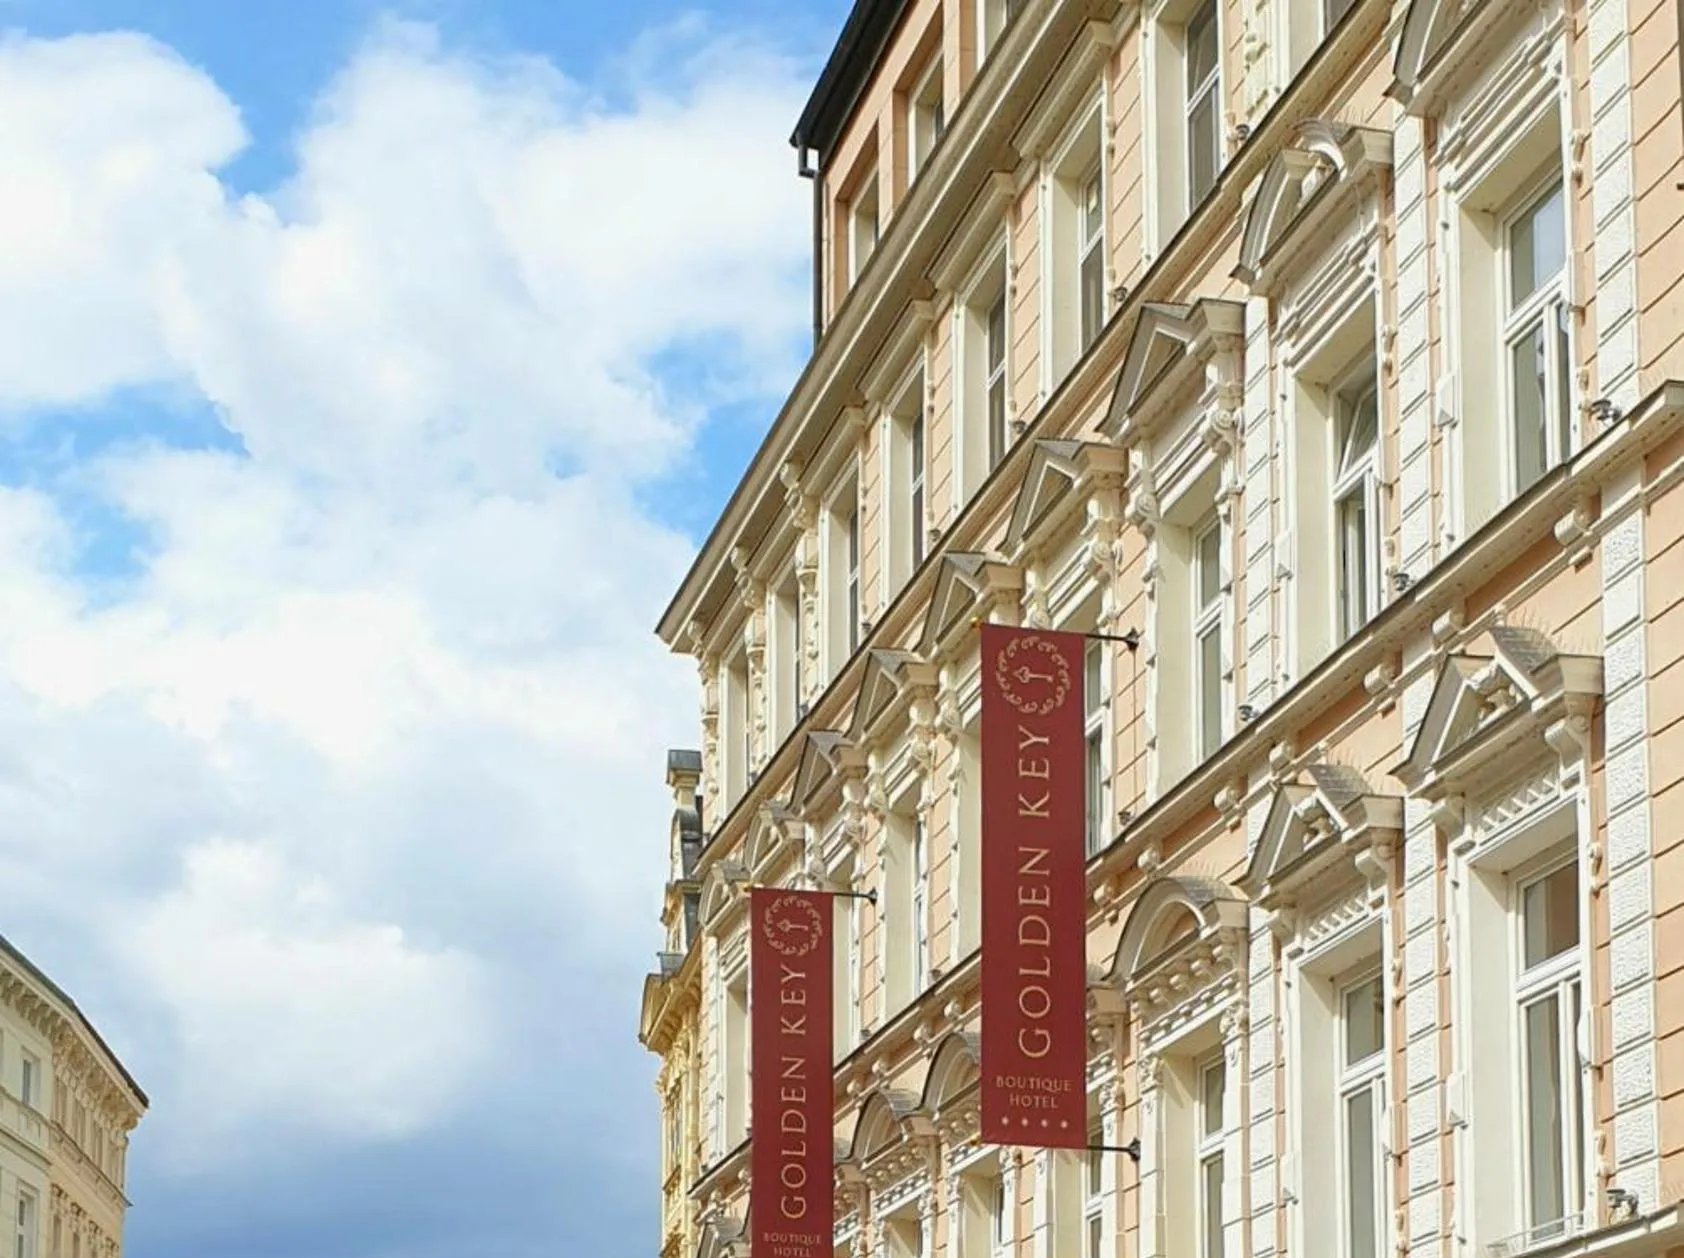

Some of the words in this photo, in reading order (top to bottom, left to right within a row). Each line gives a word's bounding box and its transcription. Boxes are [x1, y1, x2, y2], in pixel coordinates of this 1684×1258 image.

[1018, 724, 1050, 818] KEY
[1018, 846, 1051, 1058] GOLDEN
[780, 963, 807, 1036] KEY
[995, 1075, 1073, 1093] BOUTIQUE
[1009, 1092, 1059, 1109] HOTEL
[780, 1056, 807, 1219] GOLDEN
[773, 1246, 813, 1258] HOTEL
